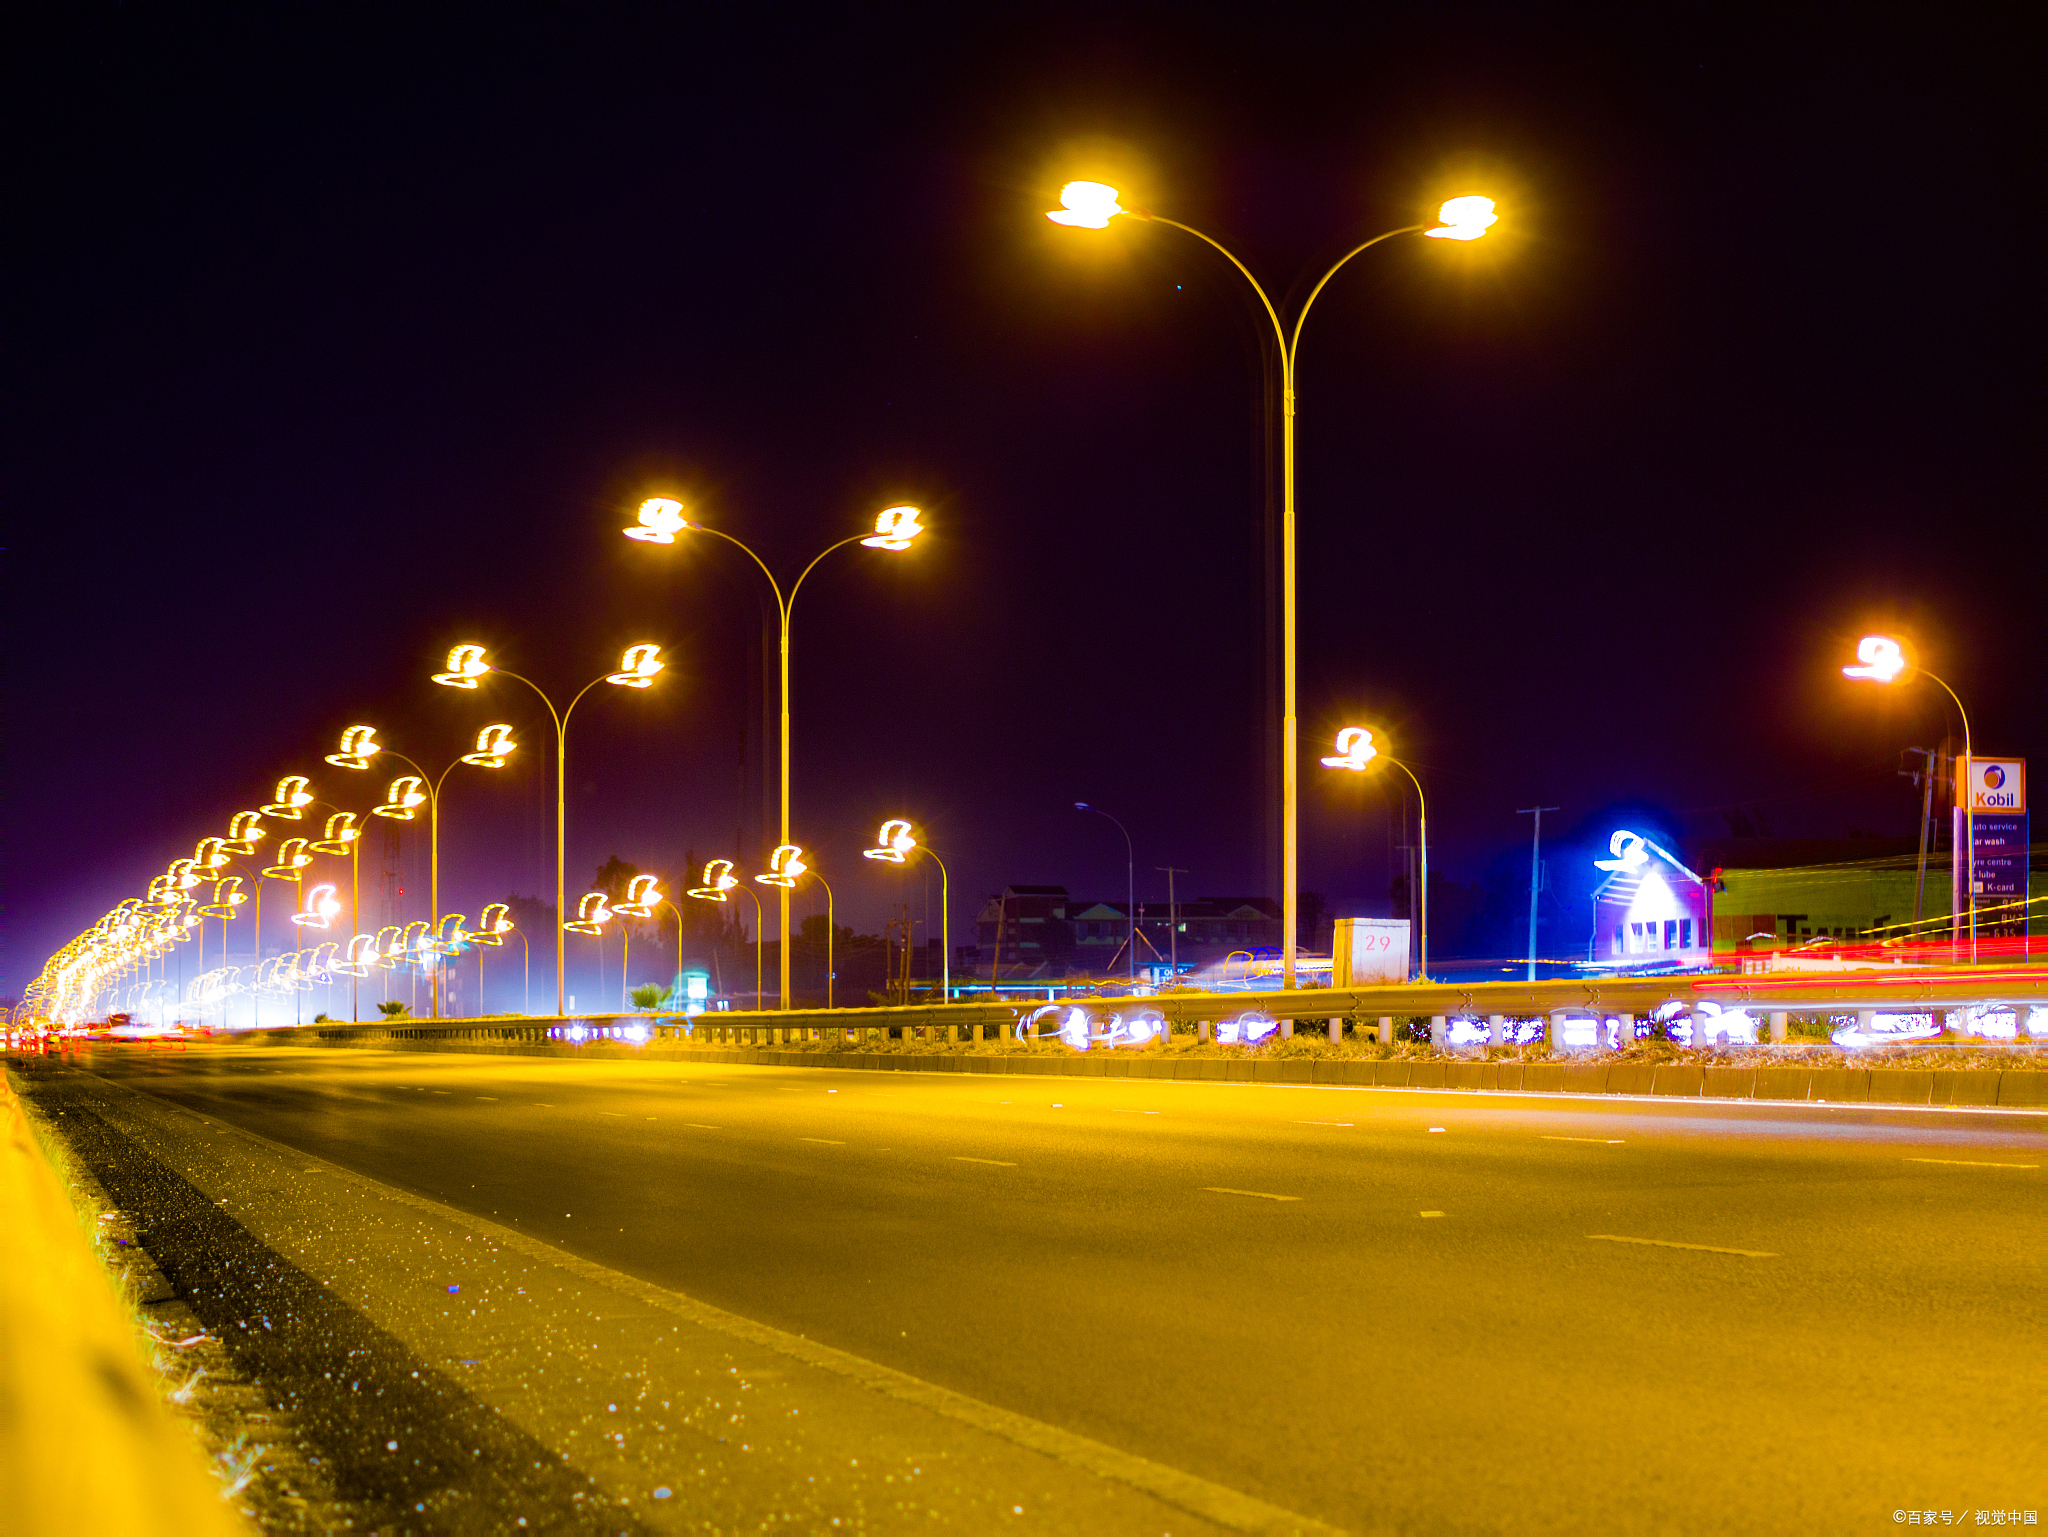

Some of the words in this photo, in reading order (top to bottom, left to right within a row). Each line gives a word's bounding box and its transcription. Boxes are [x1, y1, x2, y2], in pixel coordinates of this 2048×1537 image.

[1975, 792, 2014, 807] Kobil
[1973, 822, 1987, 831] uto
[1989, 822, 2018, 831] service
[1984, 837, 2006, 846] wash
[1986, 858, 2012, 867] centre
[1987, 882, 2015, 892] K-card
[1365, 934, 1391, 952] 29
